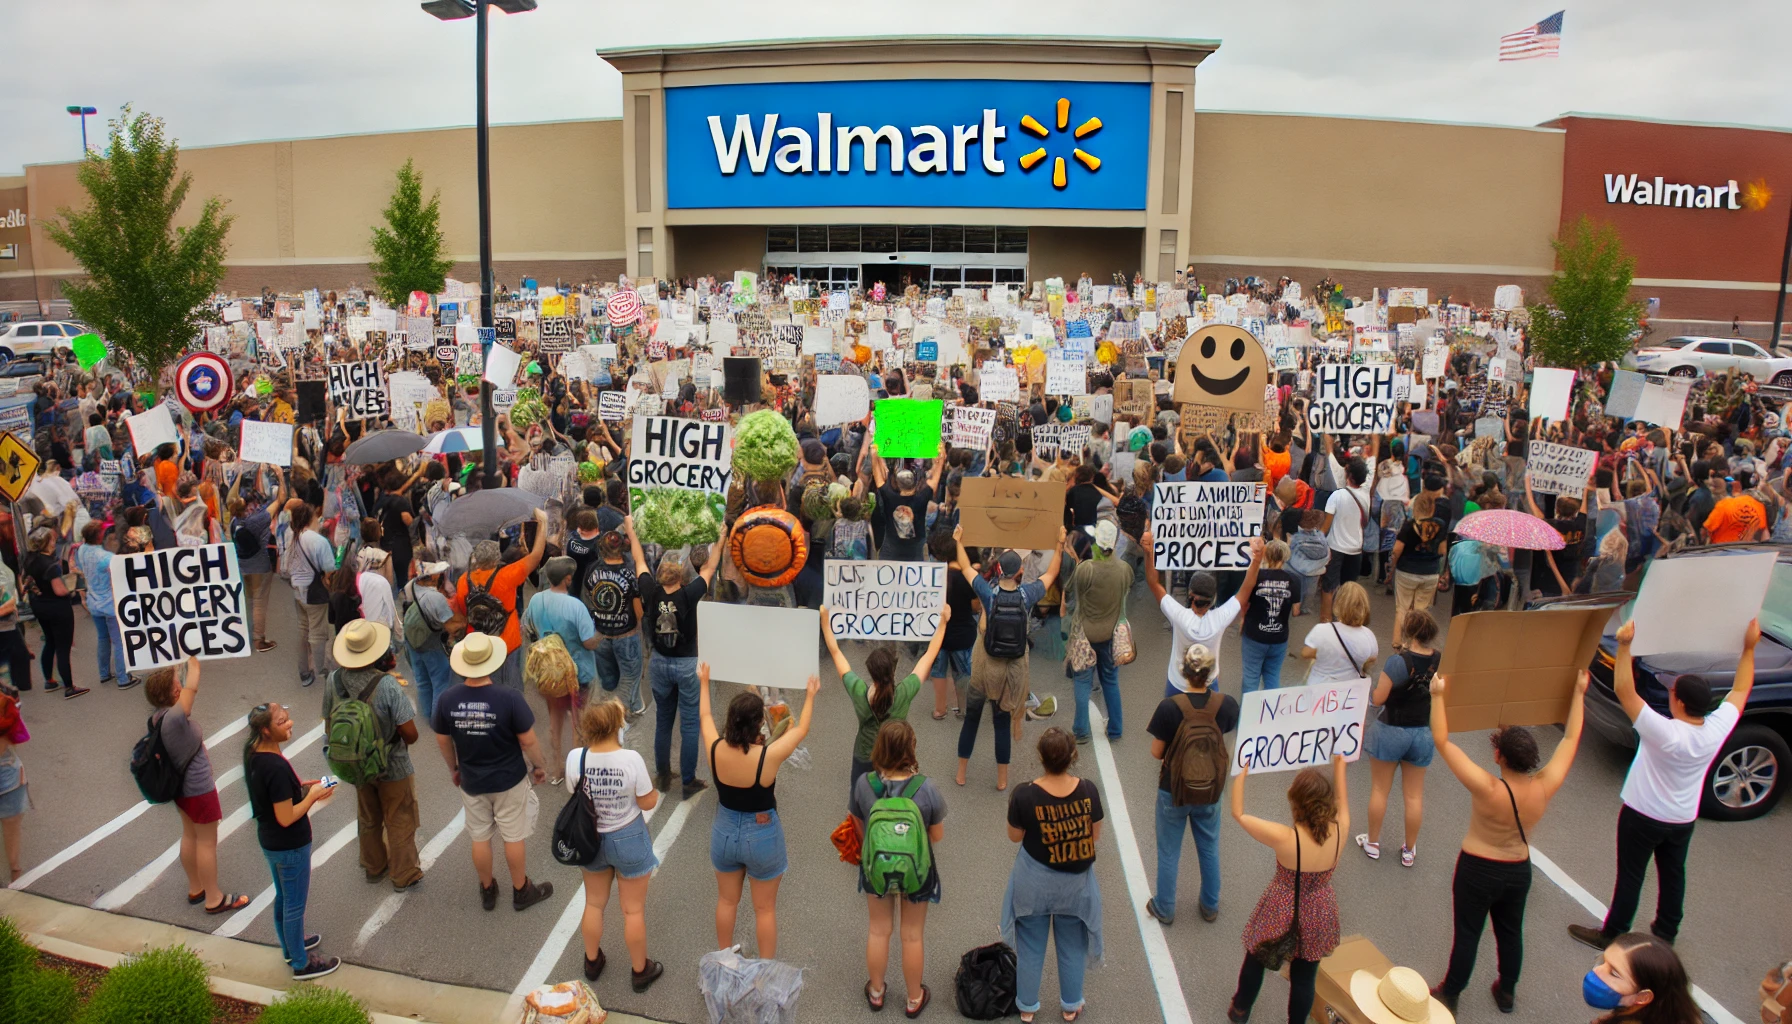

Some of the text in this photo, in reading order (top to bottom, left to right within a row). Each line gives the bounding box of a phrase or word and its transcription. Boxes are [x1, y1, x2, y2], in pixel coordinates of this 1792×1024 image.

[707, 108, 1006, 174] Walmart
[1604, 173, 1741, 210] Walmart
[329, 362, 380, 390] HIGH
[1320, 365, 1394, 399] HIGH
[1308, 402, 1395, 431] GROCERY
[645, 417, 725, 460] HIGH
[629, 459, 732, 493] GROCERY
[124, 545, 229, 592] HIGH
[118, 582, 243, 627] GROCERY
[124, 616, 246, 667] PRICES
[1238, 722, 1360, 769] GROCERYS
